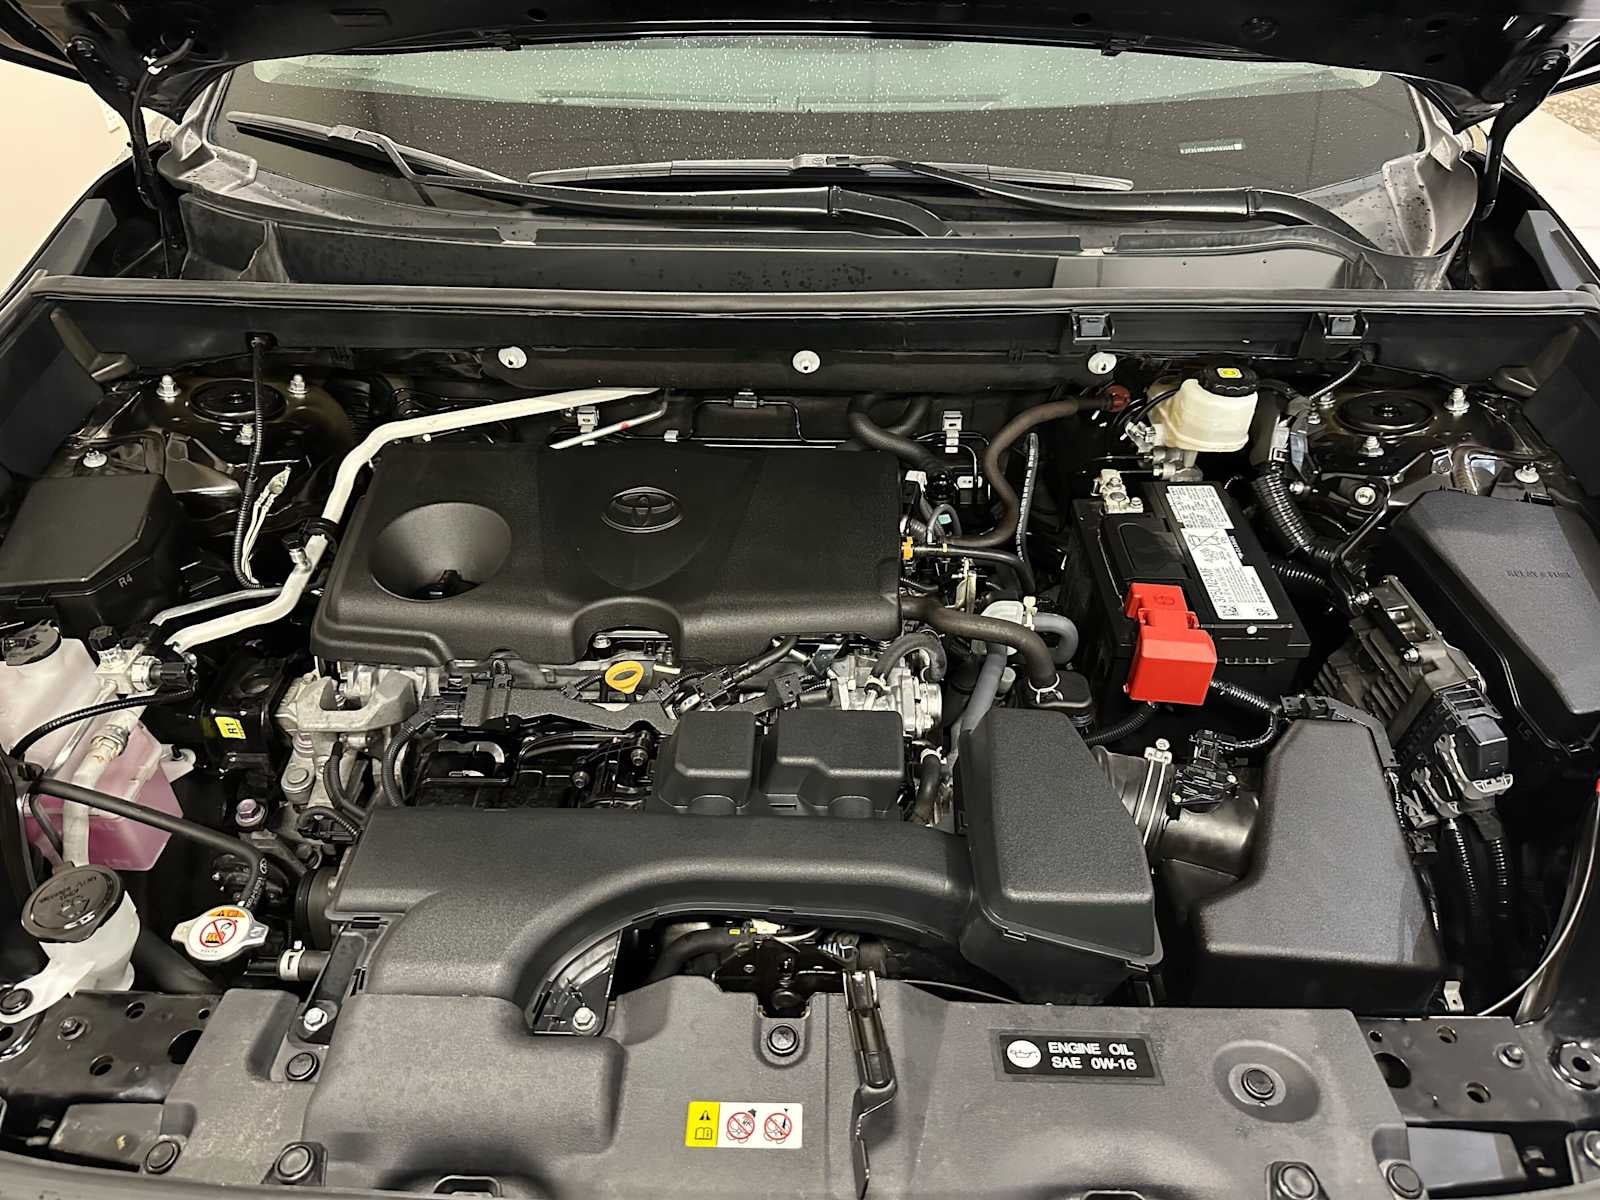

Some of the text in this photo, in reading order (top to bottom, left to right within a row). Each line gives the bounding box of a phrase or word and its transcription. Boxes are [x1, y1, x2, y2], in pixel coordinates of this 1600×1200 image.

[118, 573, 133, 588] R4
[1048, 1042, 1134, 1056] ENGINE OIL
[1051, 1056, 1138, 1071] SAE 0W-16
